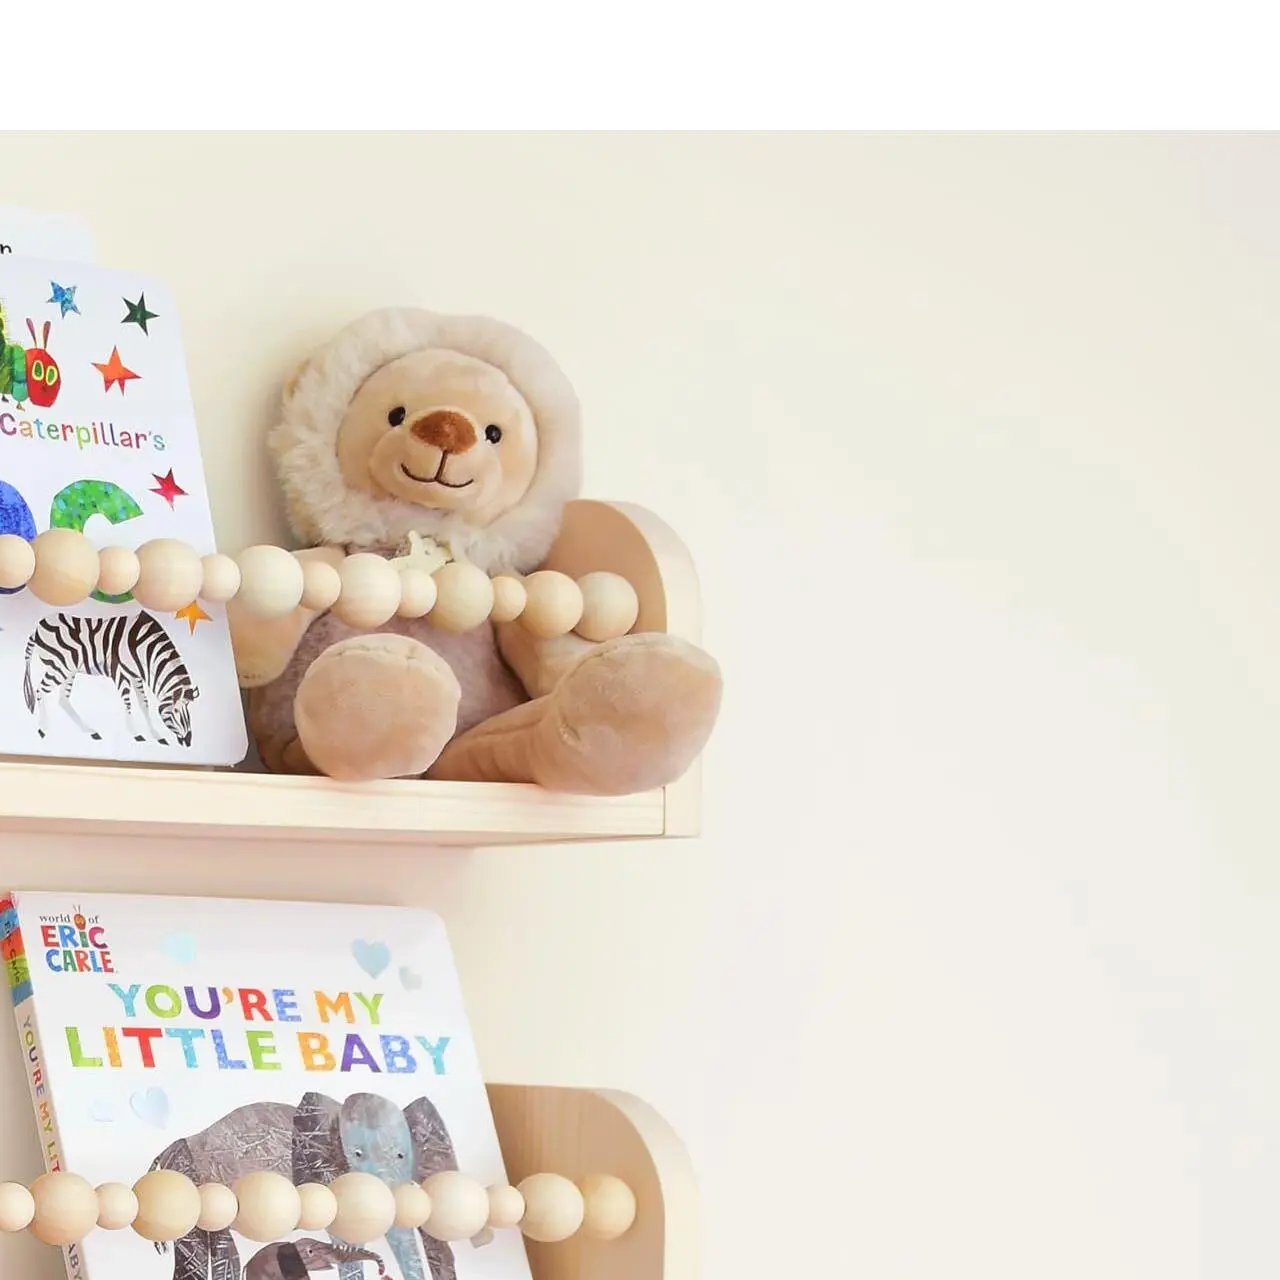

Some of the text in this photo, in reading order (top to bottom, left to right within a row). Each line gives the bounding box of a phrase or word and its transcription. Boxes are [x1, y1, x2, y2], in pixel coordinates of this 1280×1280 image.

[39, 913, 100, 924] world of
[45, 948, 115, 974] CARLE
[107, 982, 384, 1026] YOU'RE MY
[64, 1026, 452, 1076] LITTLE BABY
[23, 1015, 46, 1097] YOU'RE
[39, 1100, 54, 1133] MY
